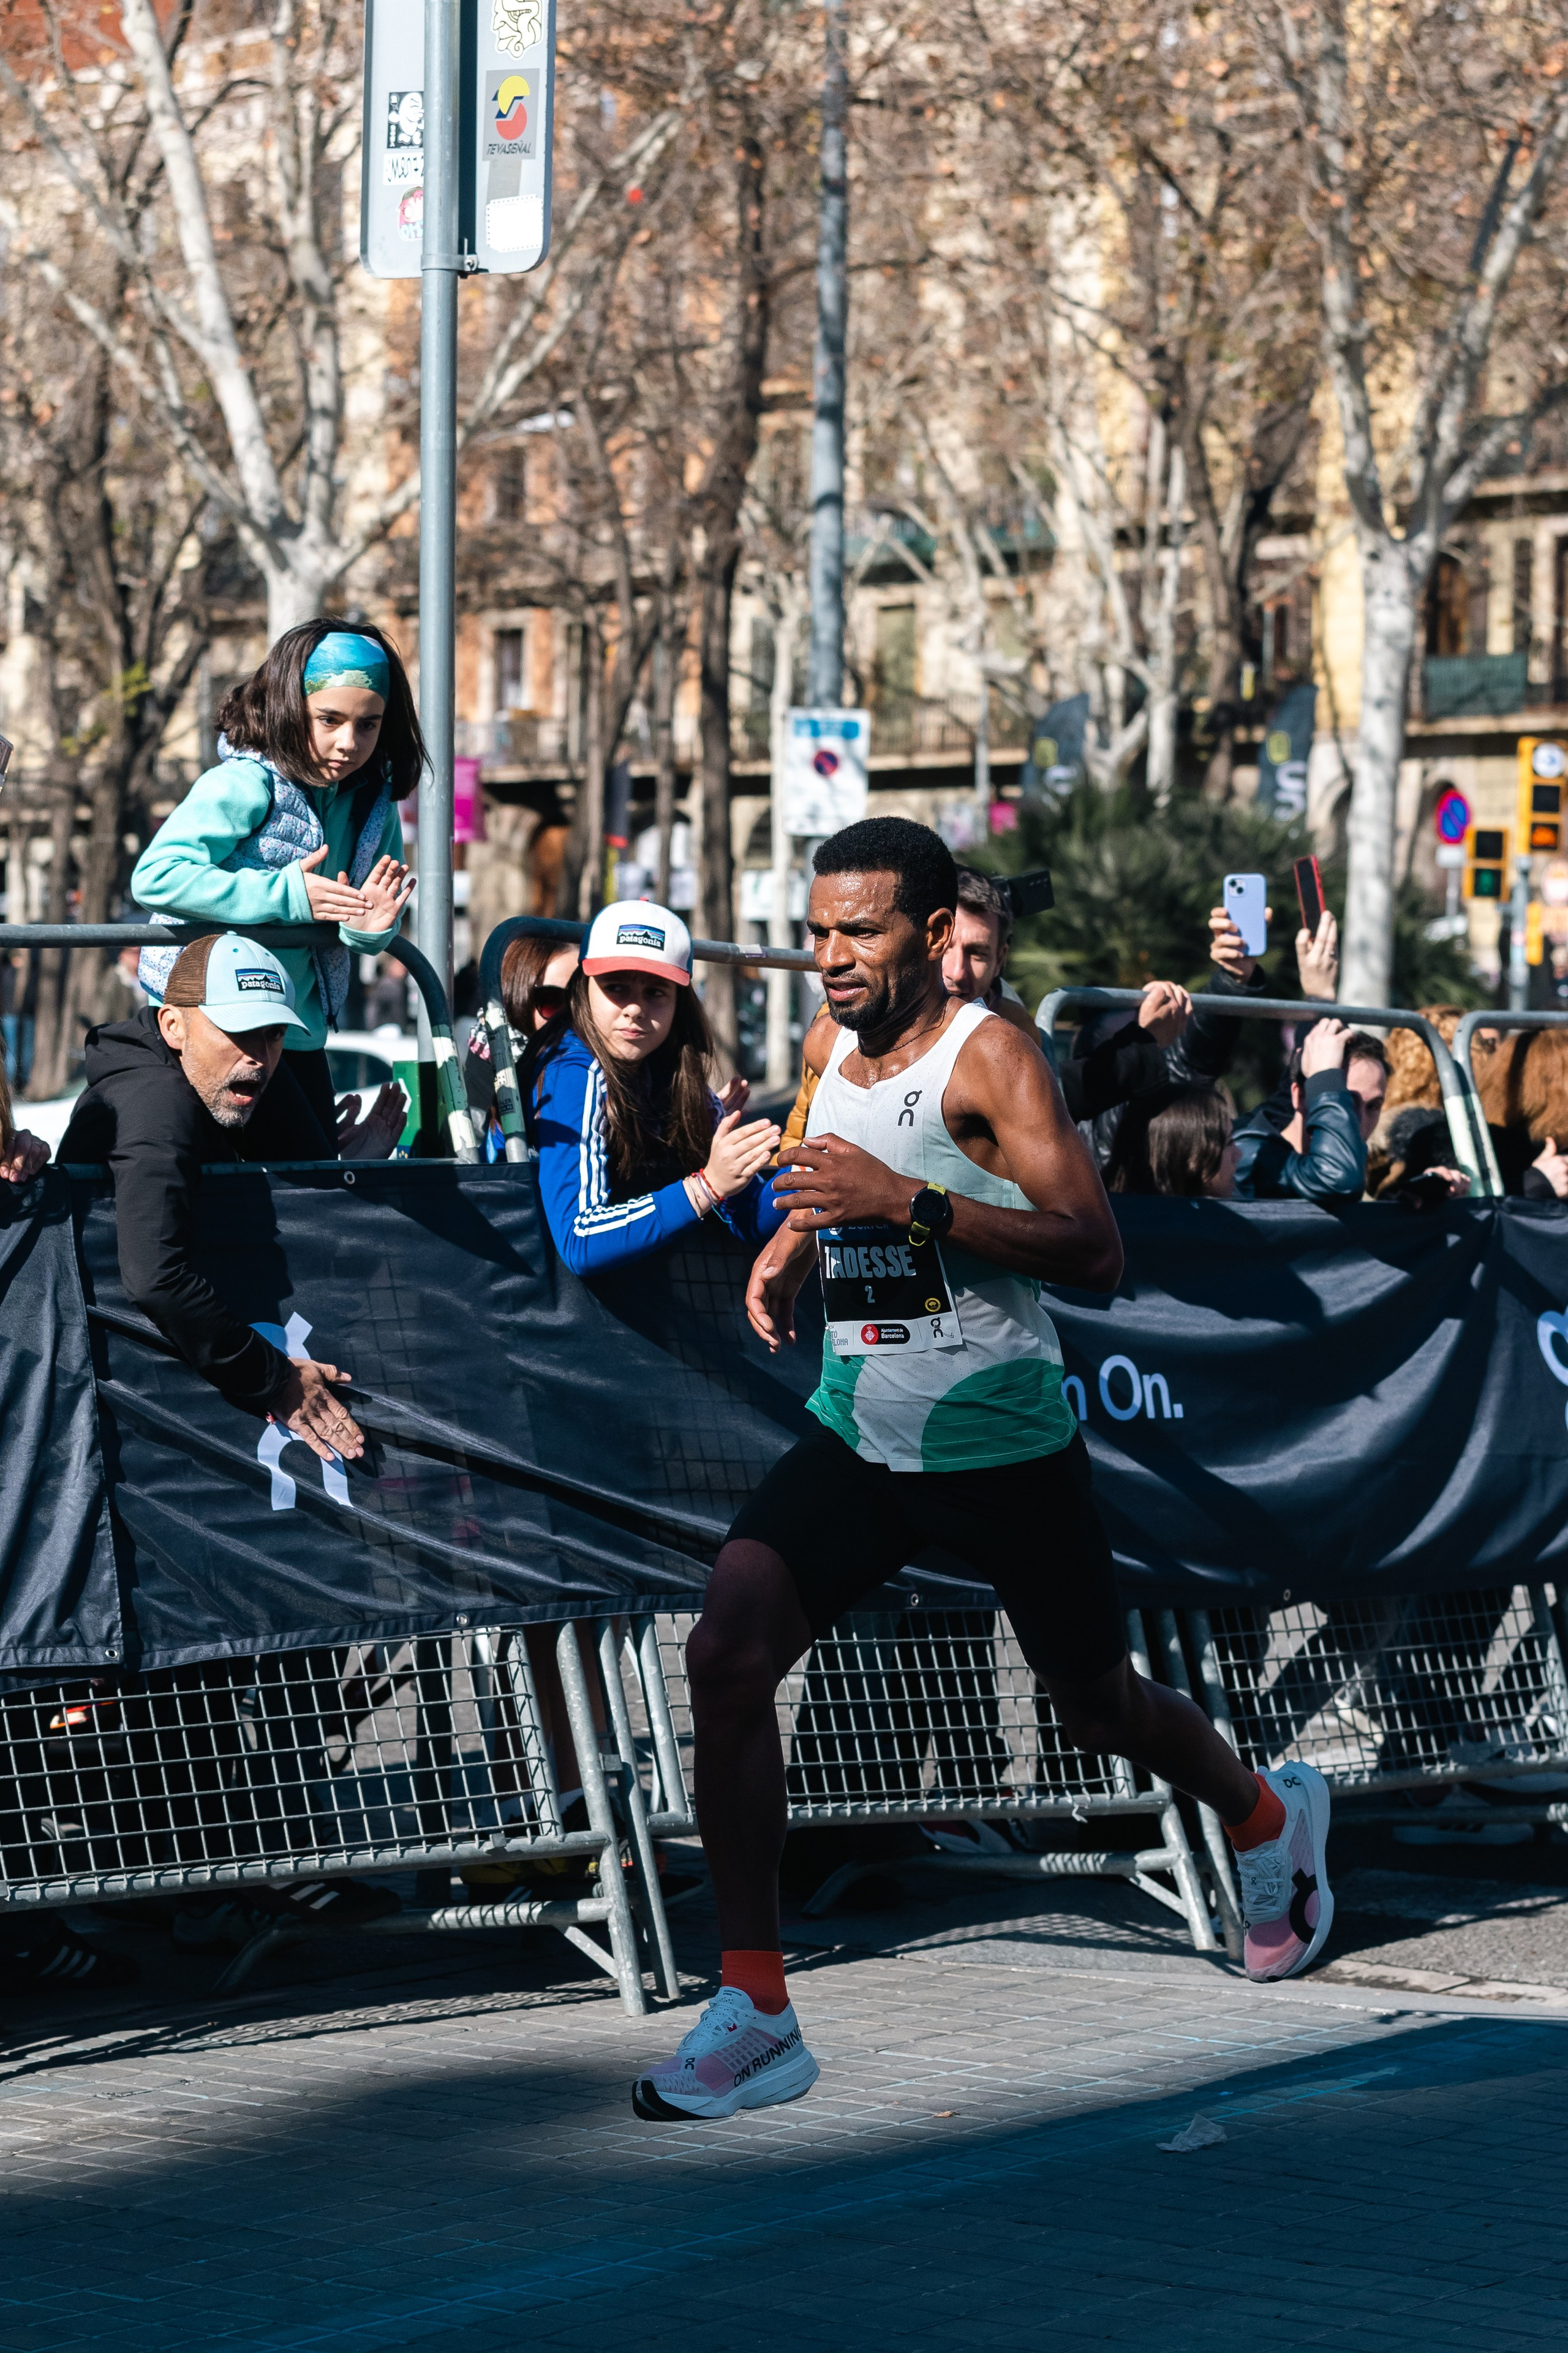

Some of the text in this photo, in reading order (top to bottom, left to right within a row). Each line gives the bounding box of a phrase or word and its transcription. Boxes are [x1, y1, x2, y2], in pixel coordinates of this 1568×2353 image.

[619, 935, 662, 947] patagonia
[241, 981, 281, 991] patagonia
[824, 1245, 916, 1278] TADESSE
[865, 1285, 875, 1303] 2
[1099, 1354, 1183, 1421] On.
[734, 2064, 751, 2087] ON
